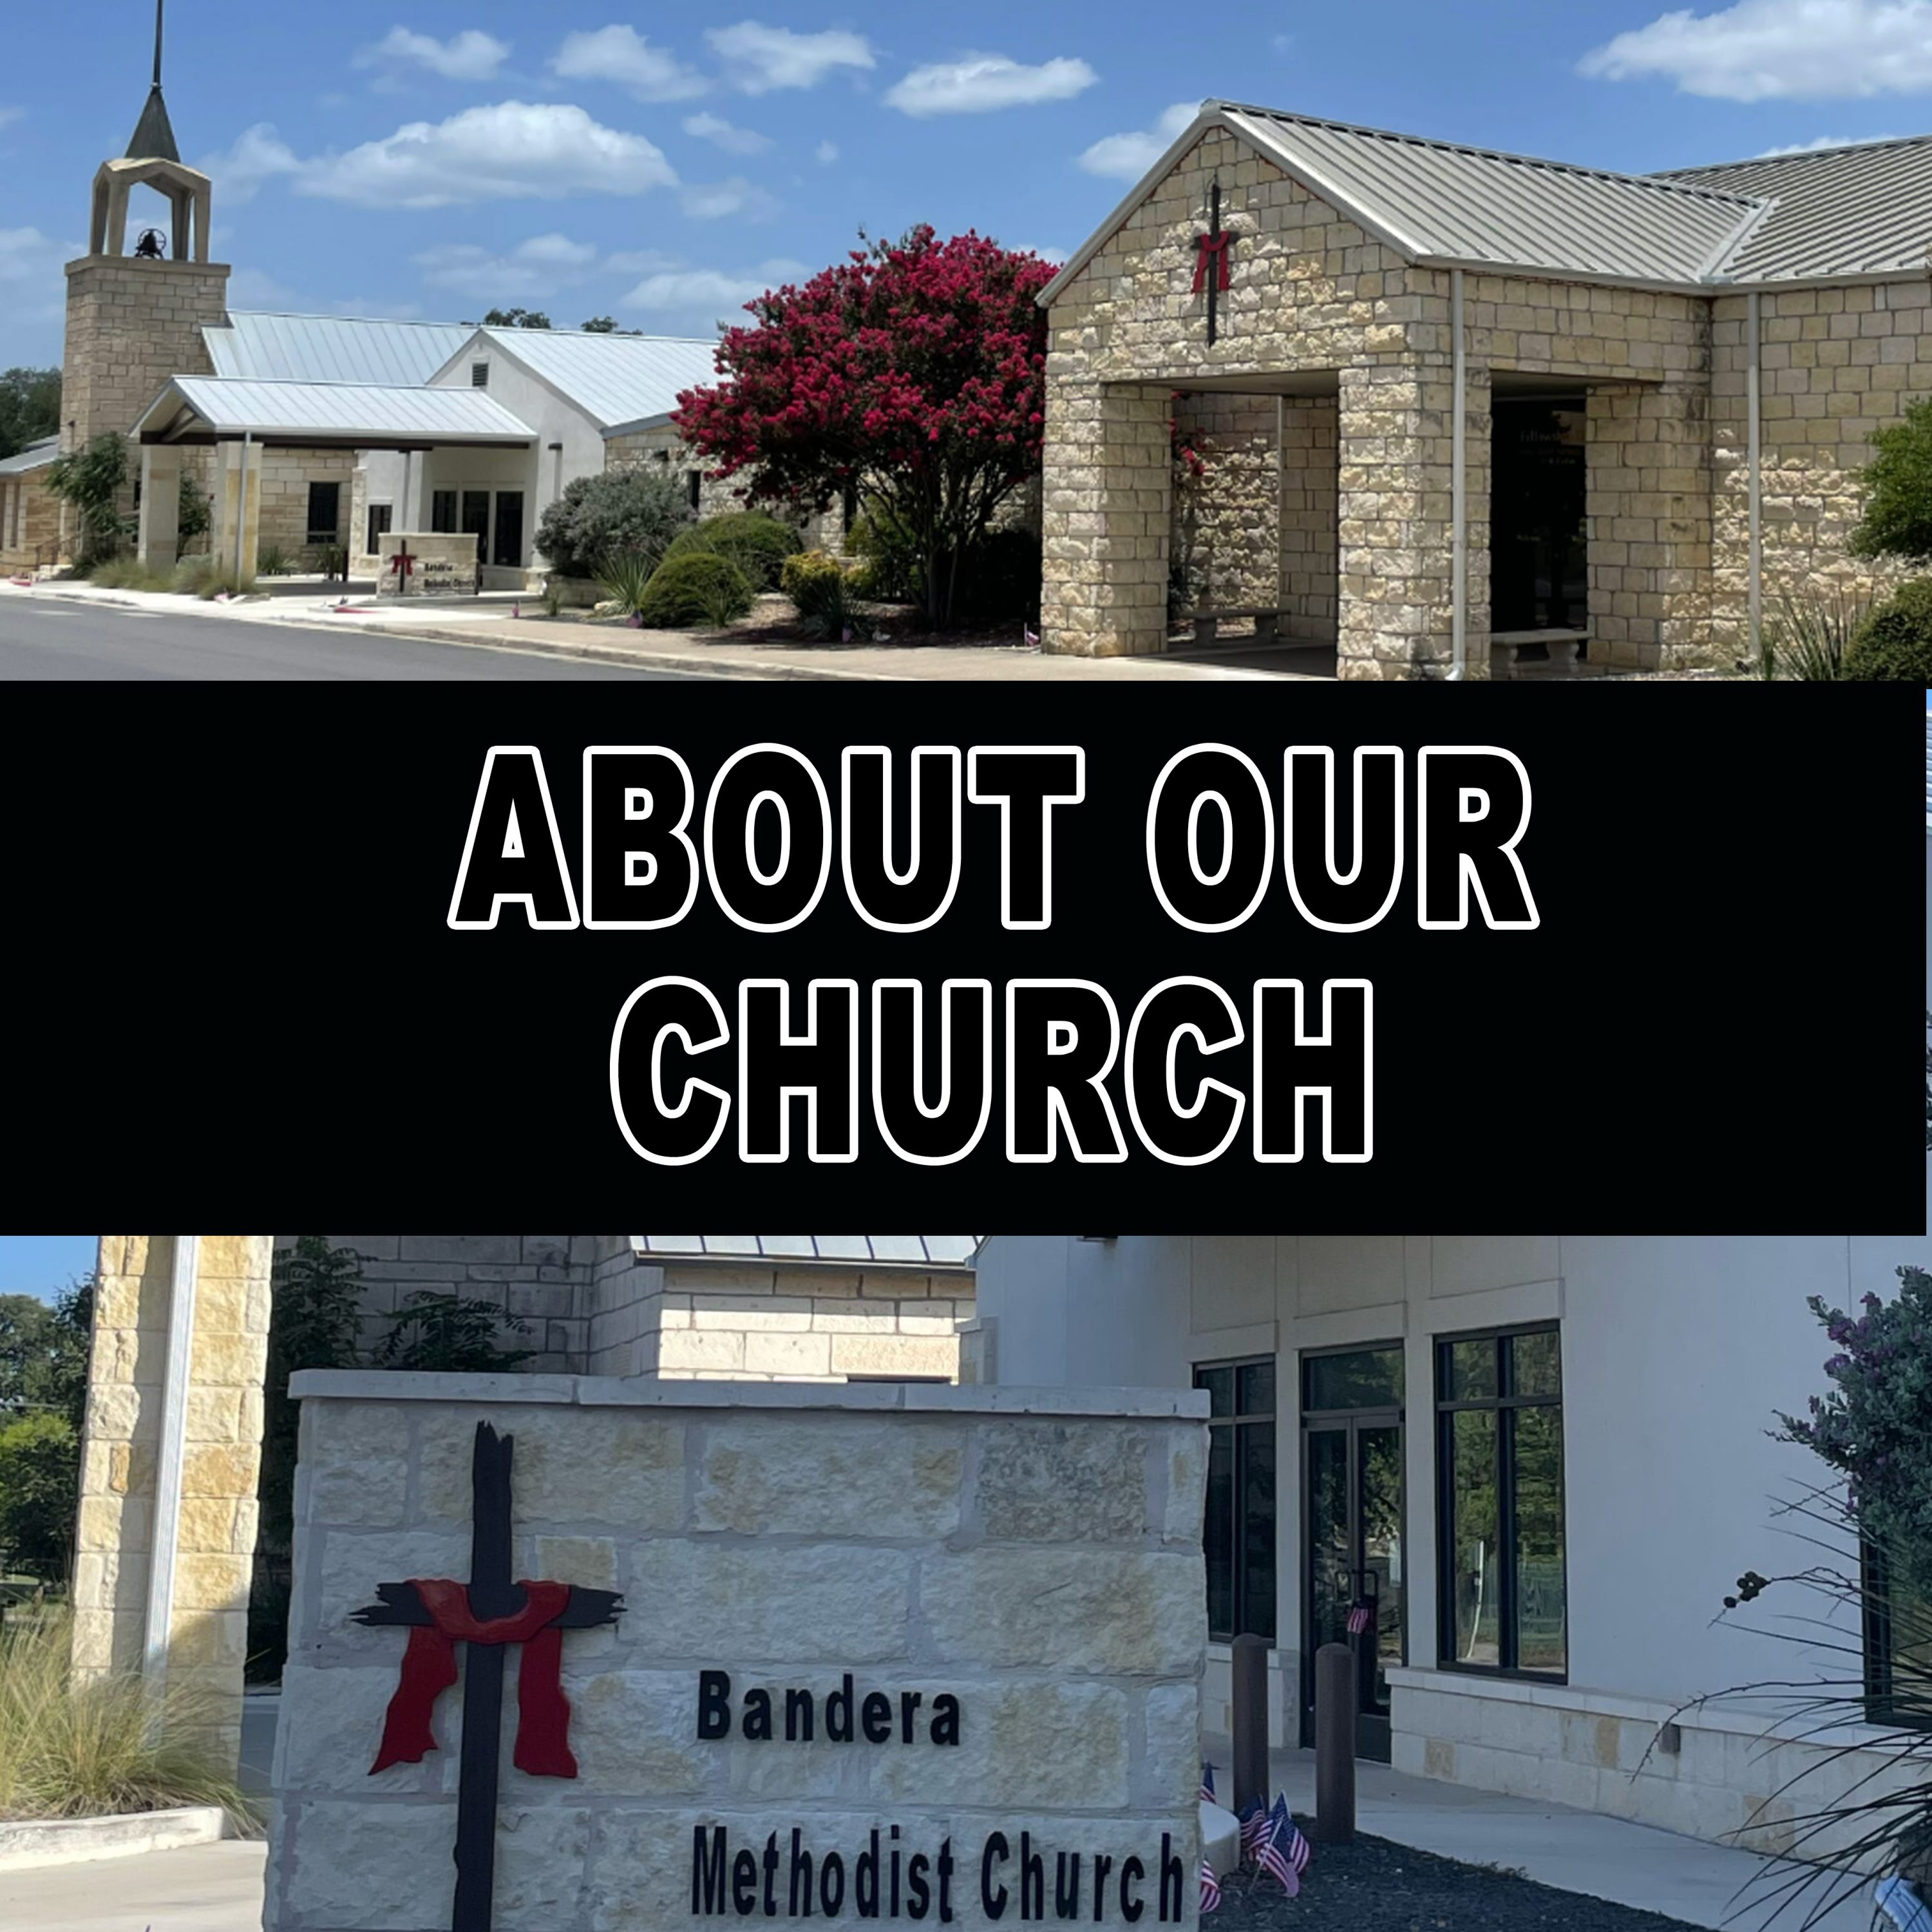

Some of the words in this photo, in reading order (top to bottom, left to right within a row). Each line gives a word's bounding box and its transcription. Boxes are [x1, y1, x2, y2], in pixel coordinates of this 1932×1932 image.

[697, 1670, 960, 1746] Bandera
[692, 1824, 954, 1923] Methodist
[981, 1831, 1183, 1923] Church
